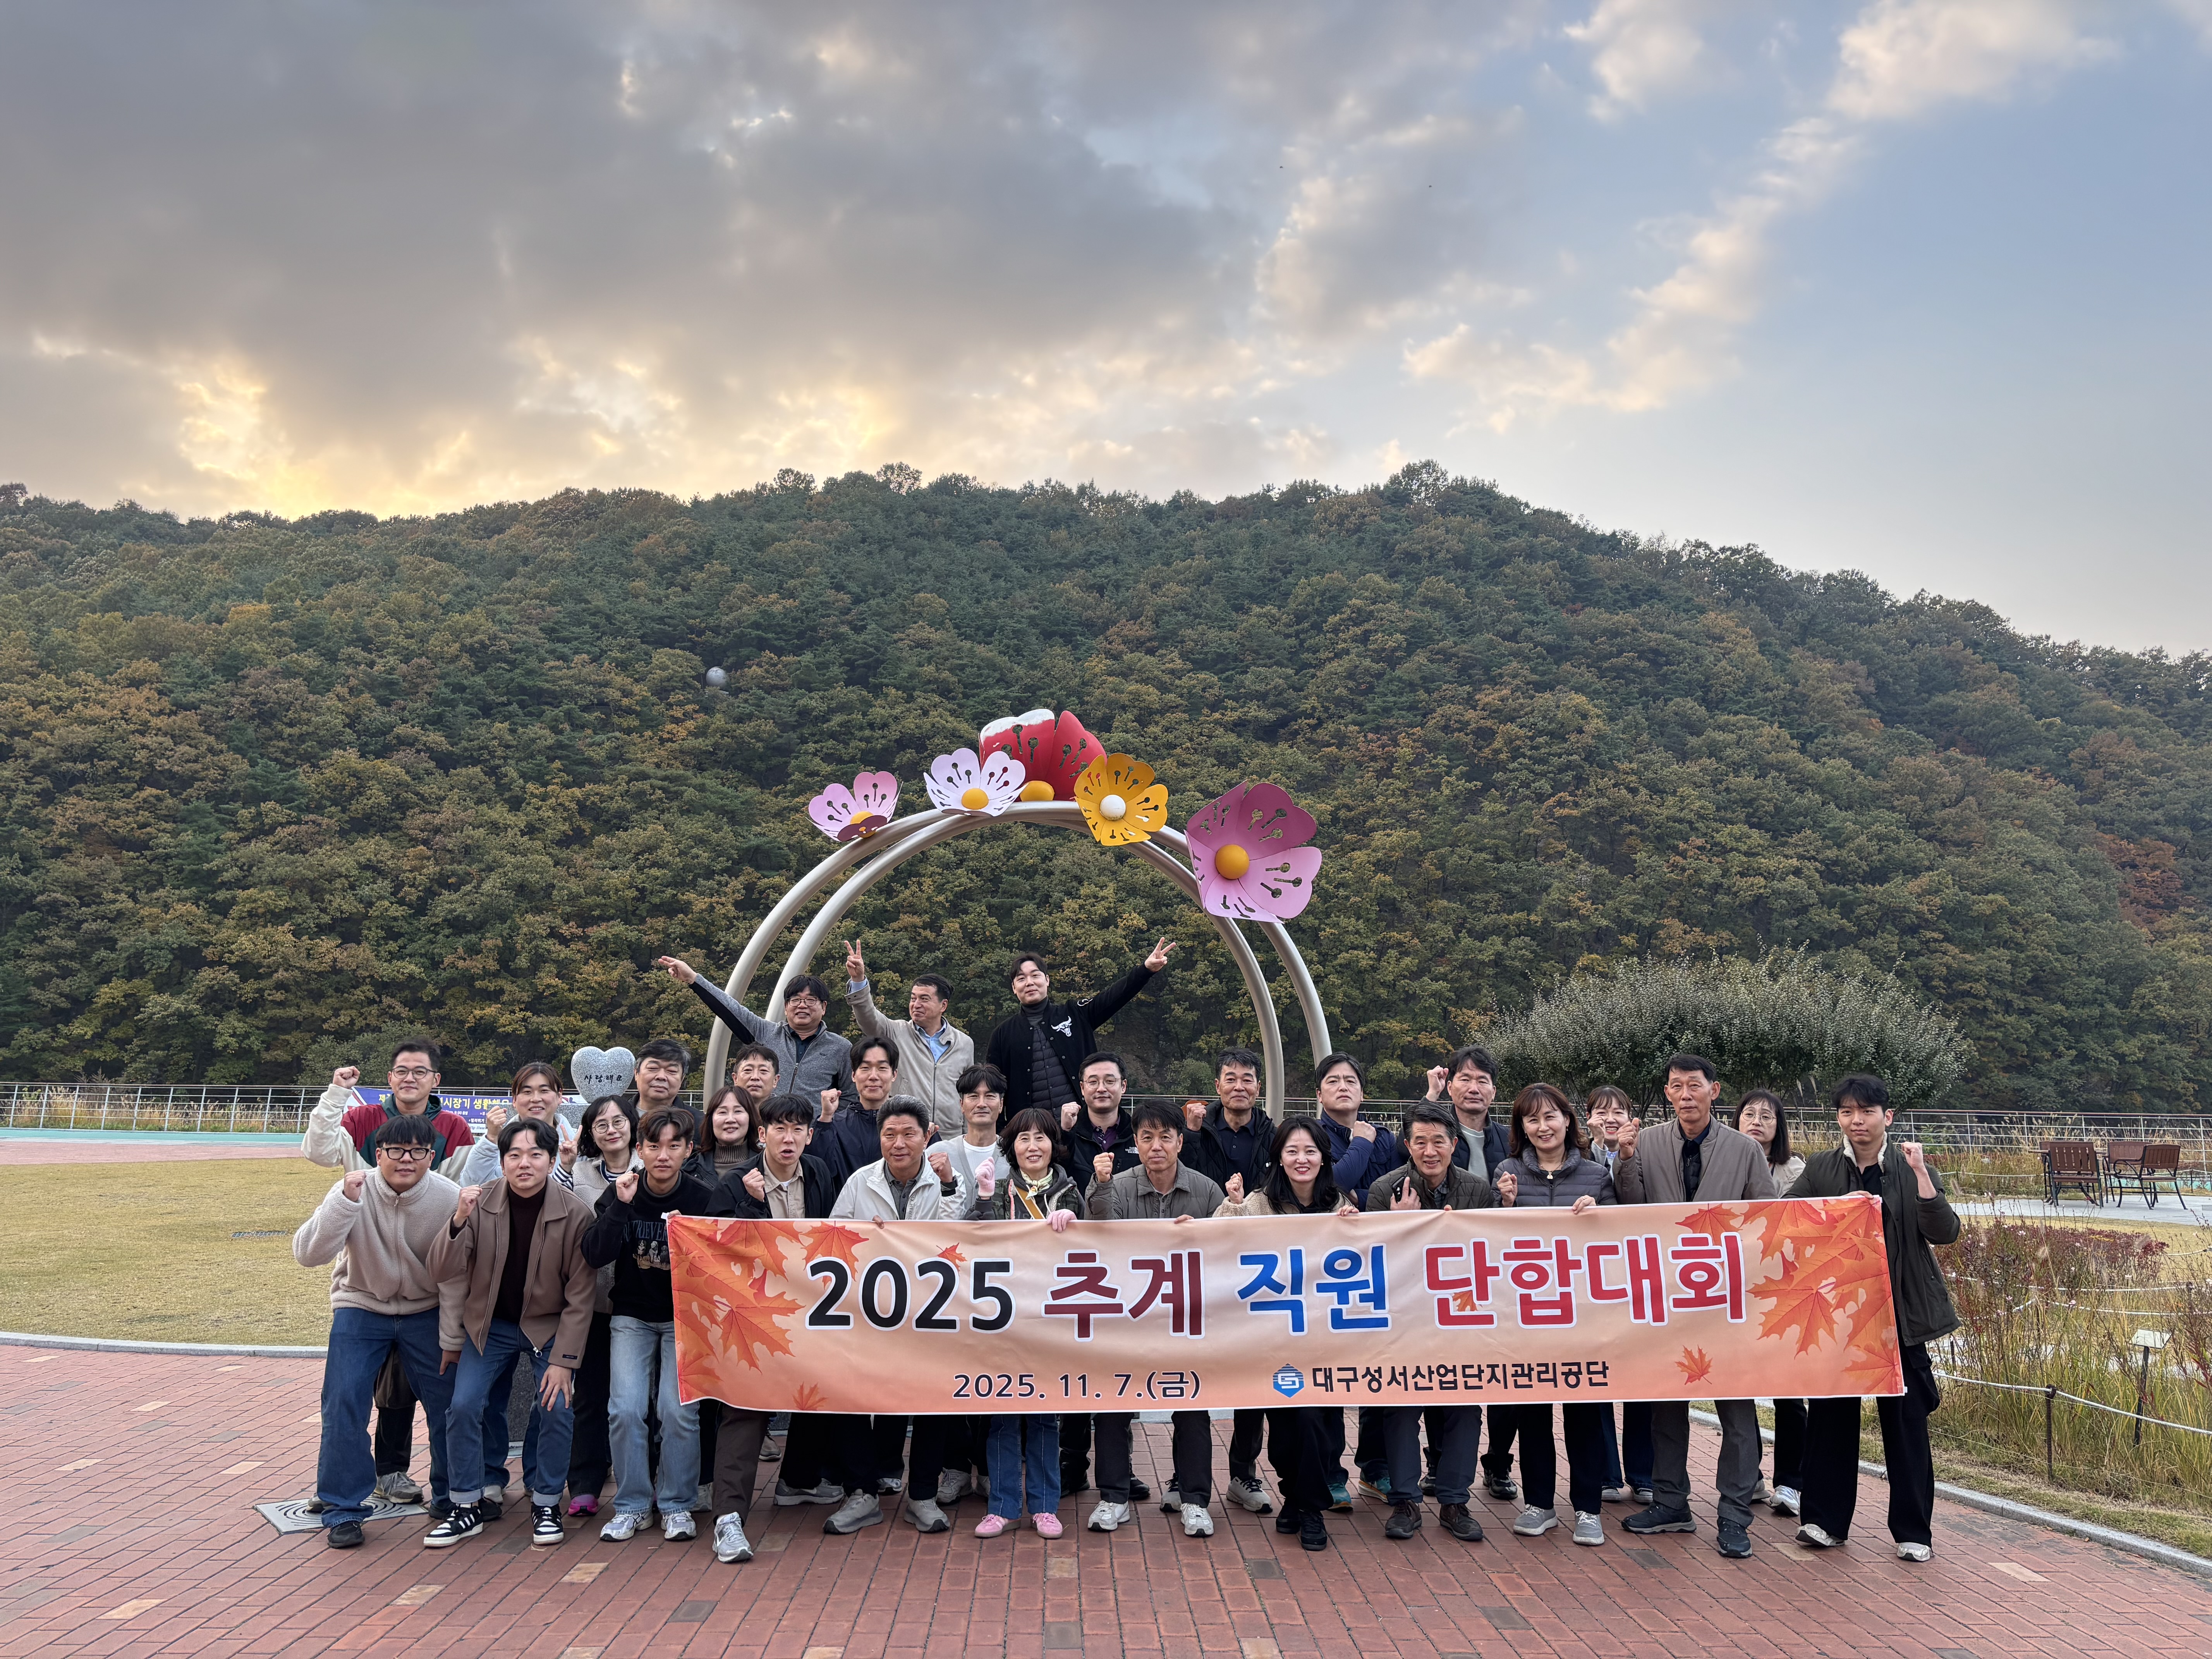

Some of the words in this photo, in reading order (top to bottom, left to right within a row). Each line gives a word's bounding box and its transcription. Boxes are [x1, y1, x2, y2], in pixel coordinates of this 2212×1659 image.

[584, 1074, 622, 1084] 사랑해요
[440, 1097, 470, 1109] 시장기
[807, 1258, 1014, 1332] 2025
[1044, 1250, 1202, 1338] 추계
[1237, 1244, 1390, 1334] 직원
[1425, 1234, 1744, 1327] 단합대회
[953, 1374, 1046, 1399] 2025.
[1059, 1374, 1101, 1398] 11.
[1114, 1371, 1200, 1400] 7.(금)
[1312, 1361, 1609, 1393] 대구성서산업단지관리공단
